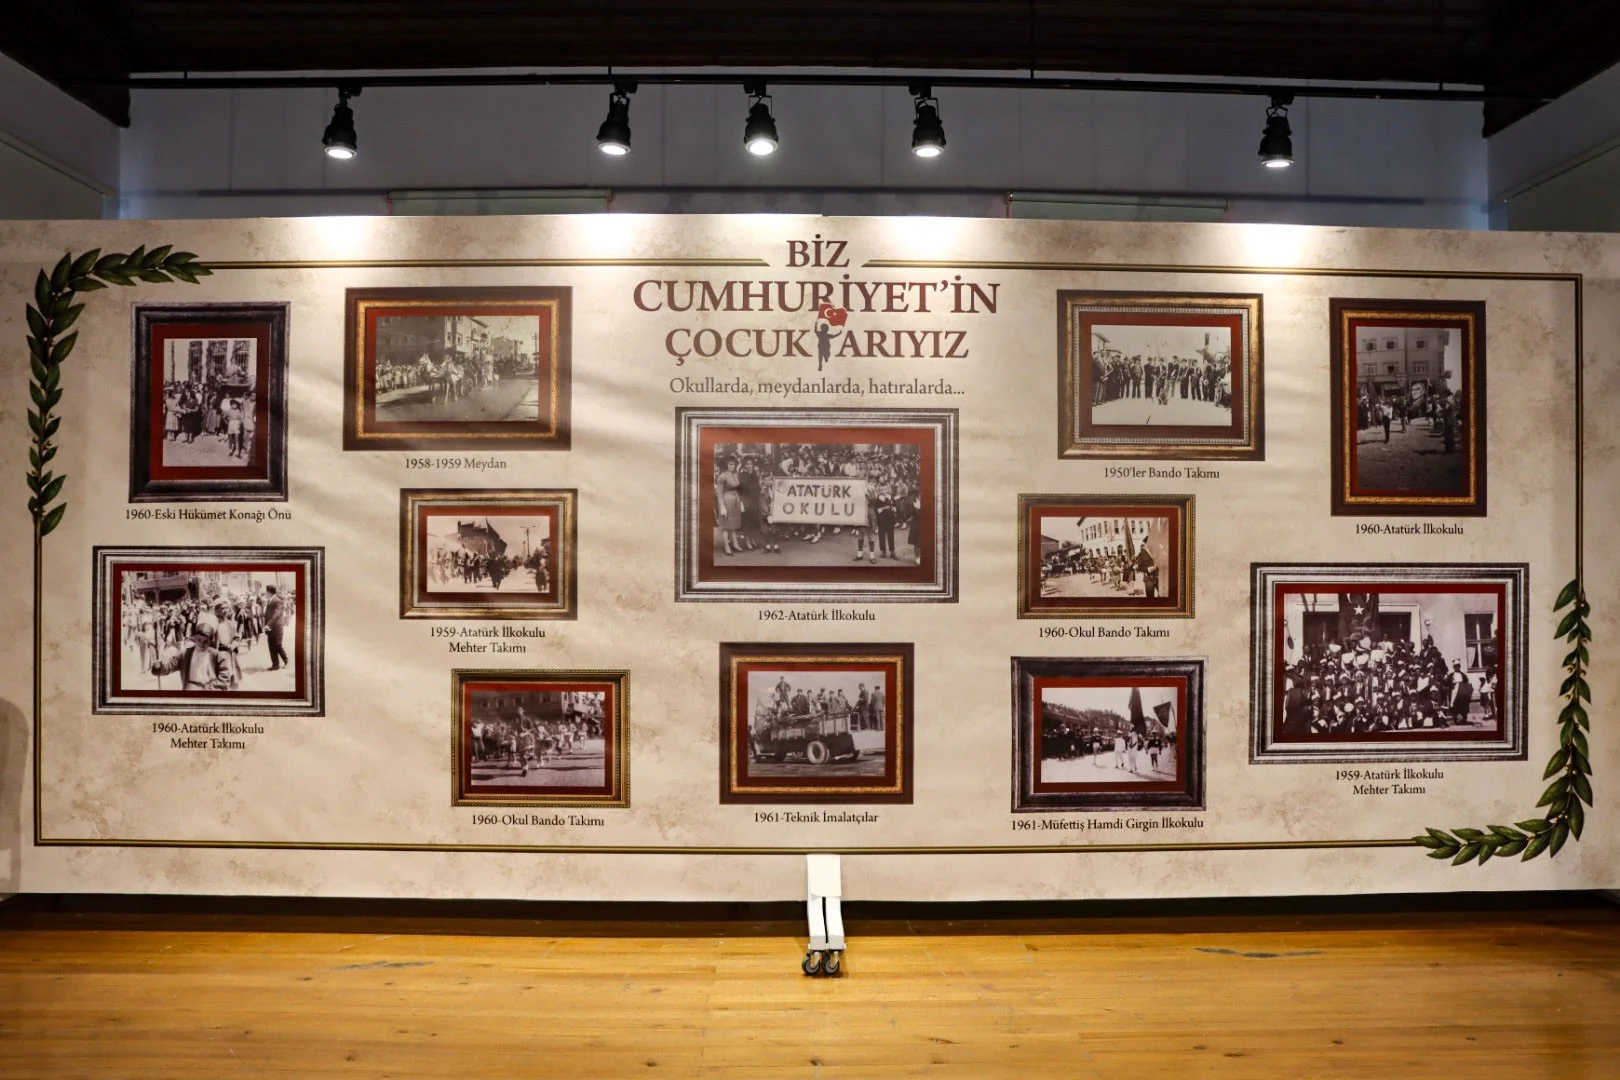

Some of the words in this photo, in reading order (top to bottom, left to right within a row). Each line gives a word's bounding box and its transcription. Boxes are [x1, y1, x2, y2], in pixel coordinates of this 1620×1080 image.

[785, 233, 851, 268] BİZ
[665, 327, 970, 367] ÇOCUKARIYIZ
[669, 377, 754, 396] Okullarda,
[757, 377, 864, 397] meydanlarda,
[868, 377, 965, 395] hatıralarda...
[405, 457, 462, 470] 1958-1959
[463, 456, 507, 473] Meydan
[1104, 466, 1147, 479] 1950'ler
[1148, 466, 1183, 479] Bando
[1183, 466, 1220, 479] Takımı
[787, 484, 852, 499] ATATÜRK
[125, 508, 176, 520] 1960-Eski
[178, 507, 227, 521] Hükümet
[228, 508, 266, 523] Konağı
[267, 507, 292, 521] Önü
[782, 502, 855, 517] OKULU
[1355, 522, 1421, 535] 1960-Atatürk
[1422, 522, 1464, 535] İlkokulu
[758, 608, 830, 621] 1962-Atatürk
[830, 607, 876, 621] İlkokulu
[430, 625, 500, 638] 1959-Atatürk
[501, 624, 547, 638] İlkokulu
[1039, 625, 1096, 639] 1960-Okul
[1097, 625, 1132, 638] Bando
[1133, 625, 1171, 638] Takımı
[448, 640, 488, 653] Mehter
[489, 641, 526, 654] Takımı
[152, 721, 221, 734] 1960-Atatürk
[220, 721, 265, 735] İlkokulu
[170, 736, 209, 749] Mehter
[209, 737, 246, 750] Takımı
[1335, 768, 1402, 782] 1959-Atatürk
[1403, 767, 1445, 780] İlkokulu
[1352, 783, 1390, 796] Mehter
[1390, 783, 1427, 795] Takımı
[472, 813, 529, 826] 1960-Okul
[530, 814, 566, 826] Bando
[567, 814, 605, 827] Takımı
[754, 811, 821, 823] 1961-Teknik
[822, 809, 880, 825] İmalatçılar
[1011, 818, 1085, 833] 1961-Müfettiş
[1086, 817, 1124, 830] Hamdi
[1125, 817, 1160, 833] Girgin
[1161, 815, 1204, 829] İlkokulu
